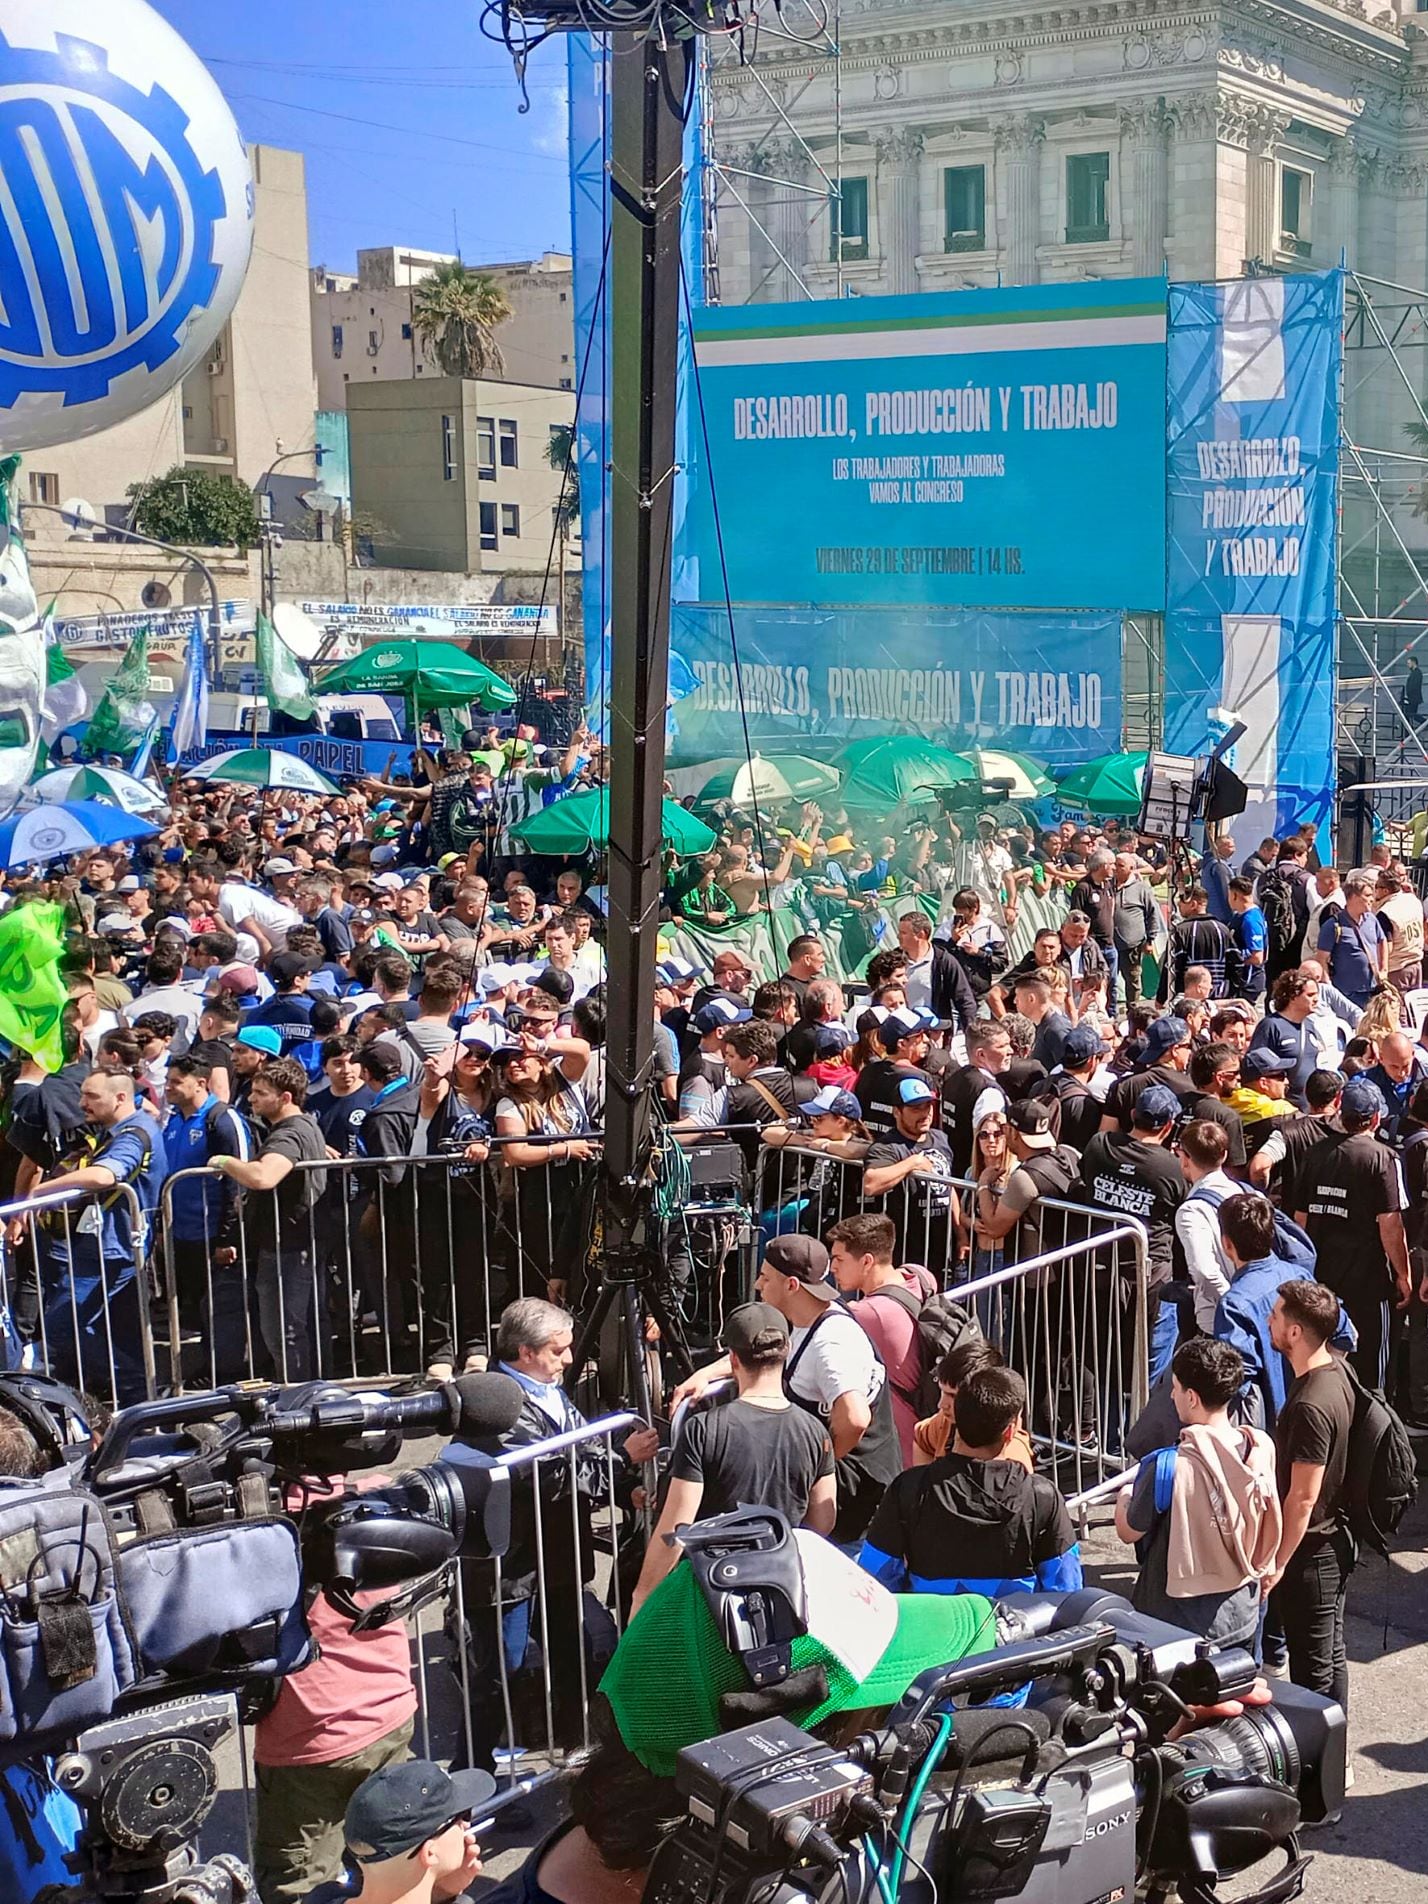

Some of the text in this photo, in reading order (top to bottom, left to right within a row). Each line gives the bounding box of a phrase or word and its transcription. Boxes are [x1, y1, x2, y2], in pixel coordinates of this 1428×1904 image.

[734, 380, 1118, 442] DESARROLLO, PRODUCCIÓN Y TRABAJO
[832, 453, 1005, 480] LOS TRABAJADORES Y TRABAJADORAS
[1196, 435, 1306, 482] DESARROLLO,
[869, 480, 964, 504] VAMOS AL CONGRESO
[1203, 481, 1305, 529] PRODUCCIÓN
[816, 547, 864, 574] VIERNES
[884, 547, 899, 574] DE
[901, 547, 976, 575] SEPTIEMBRE
[987, 547, 1001, 574] 14
[1205, 537, 1300, 577] Y TRABAJO
[303, 603, 315, 614] EL
[828, 659, 961, 724] PRODUCCIÓN
[971, 671, 986, 725] Y
[996, 671, 1102, 729] TRABAJO
[299, 739, 366, 775] PAPEL
[1093, 1176, 1156, 1205] CELESTE
[1093, 1188, 1152, 1217] BLANCA
[1085, 1810, 1132, 1842] SONY
